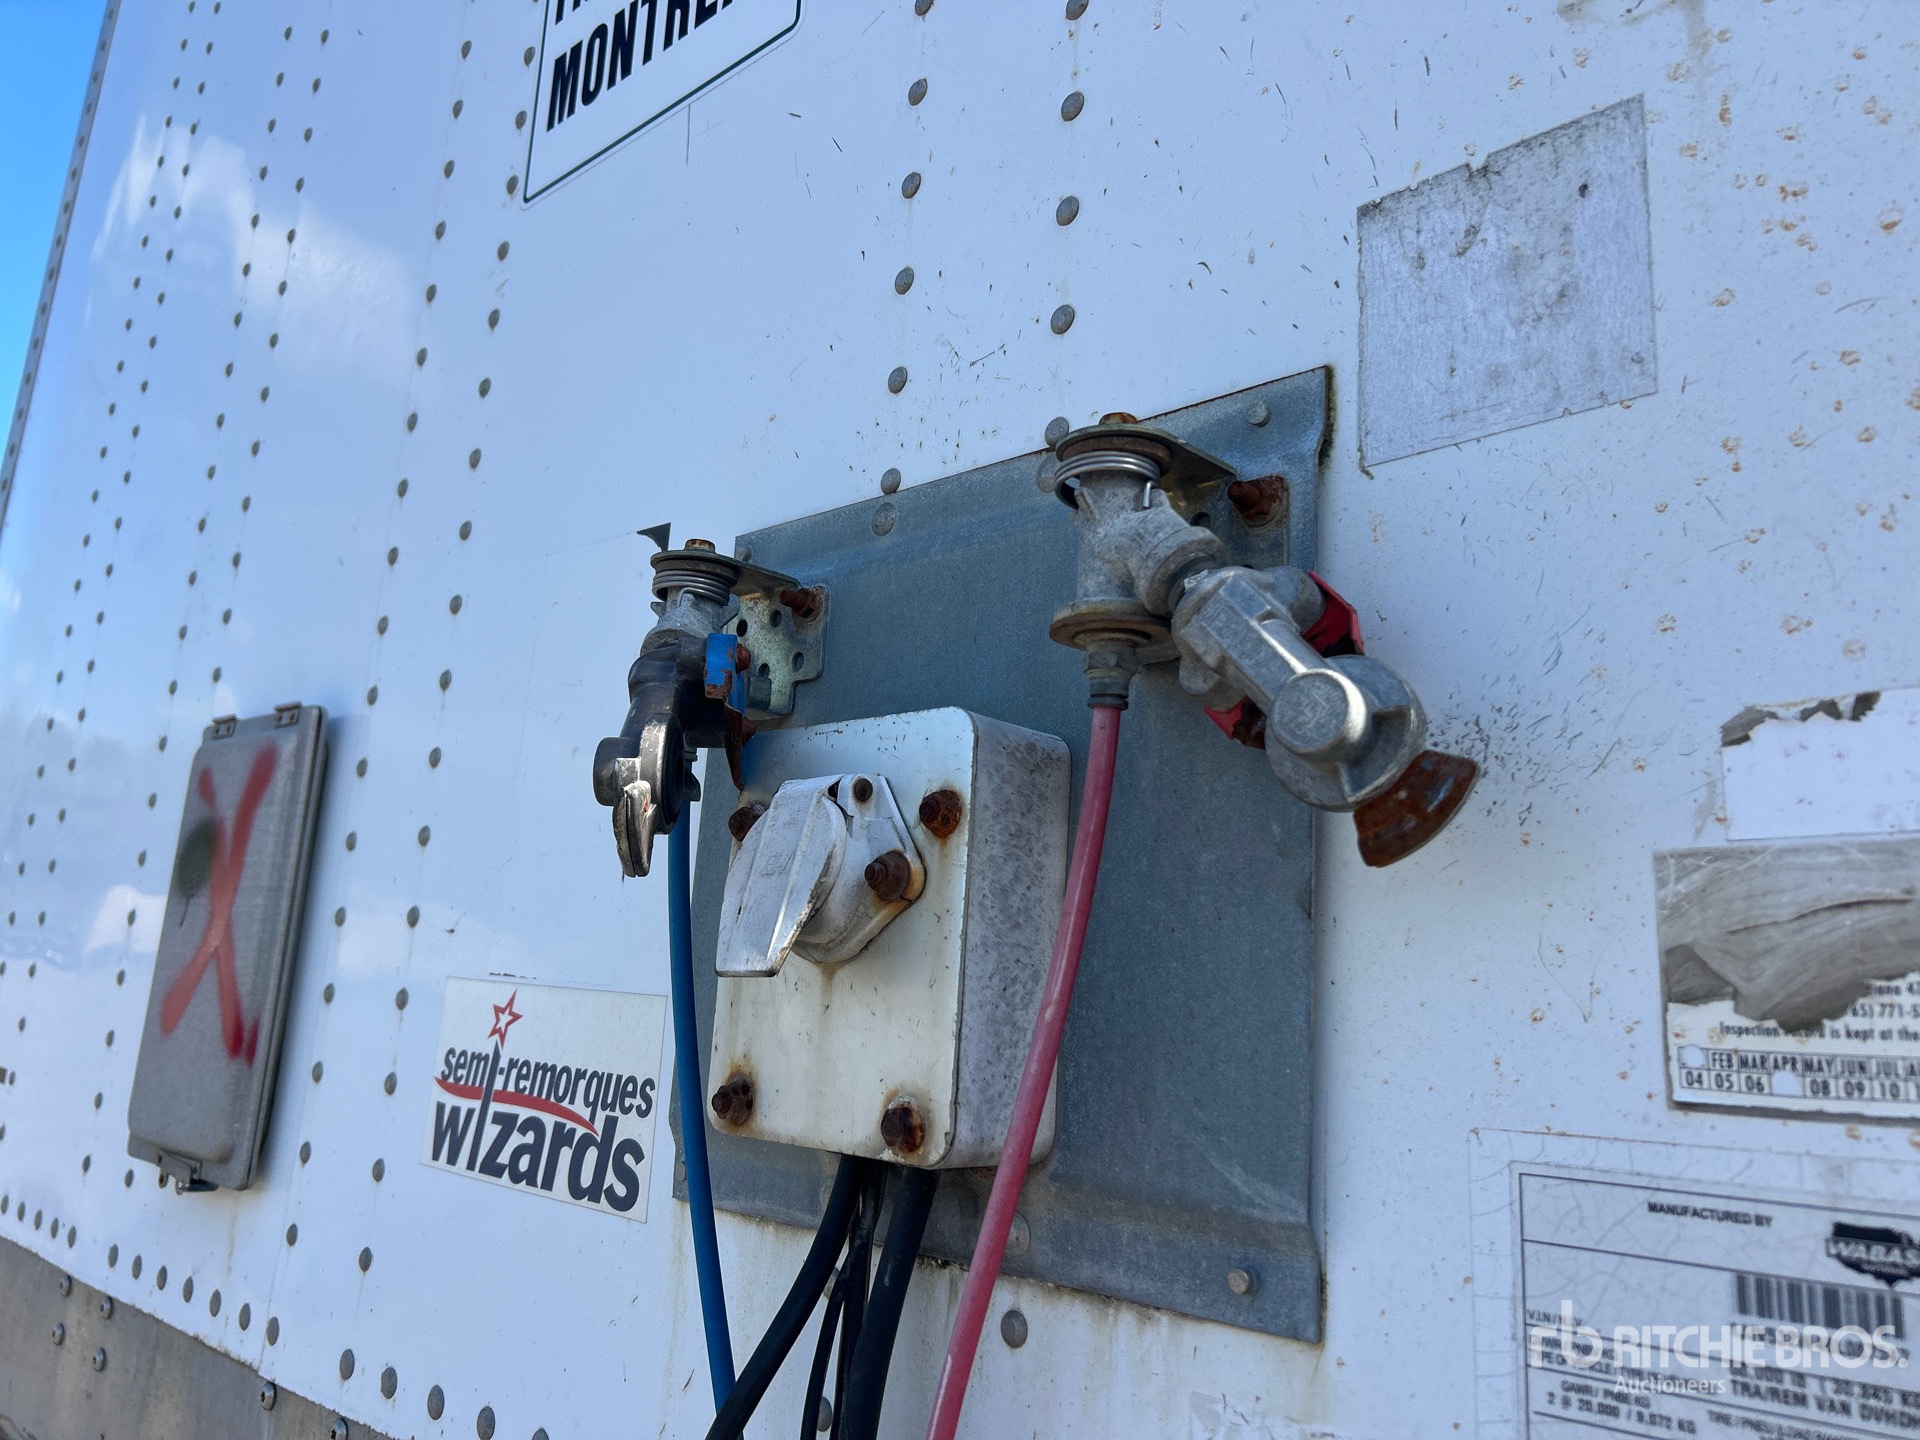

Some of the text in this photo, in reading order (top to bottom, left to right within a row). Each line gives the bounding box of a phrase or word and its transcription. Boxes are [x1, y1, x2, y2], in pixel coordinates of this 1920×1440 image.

[1719, 1021, 1780, 1037] Inspection
[1711, 1051, 1734, 1069] FEB
[1740, 1053, 1768, 1071] MAR
[1773, 1055, 1799, 1073] APR
[1803, 1057, 1834, 1074] MAY
[1840, 1059, 1867, 1075] JUN
[440, 1045, 656, 1126] semi-remorques
[1685, 1070, 1704, 1088] 04
[1714, 1072, 1734, 1091] 05
[1744, 1074, 1765, 1093] 06
[1809, 1078, 1831, 1097] 08
[1844, 1080, 1866, 1098] 09
[1879, 1081, 1901, 1100] 10
[1647, 1201, 1773, 1228] MANUFACTURED BY
